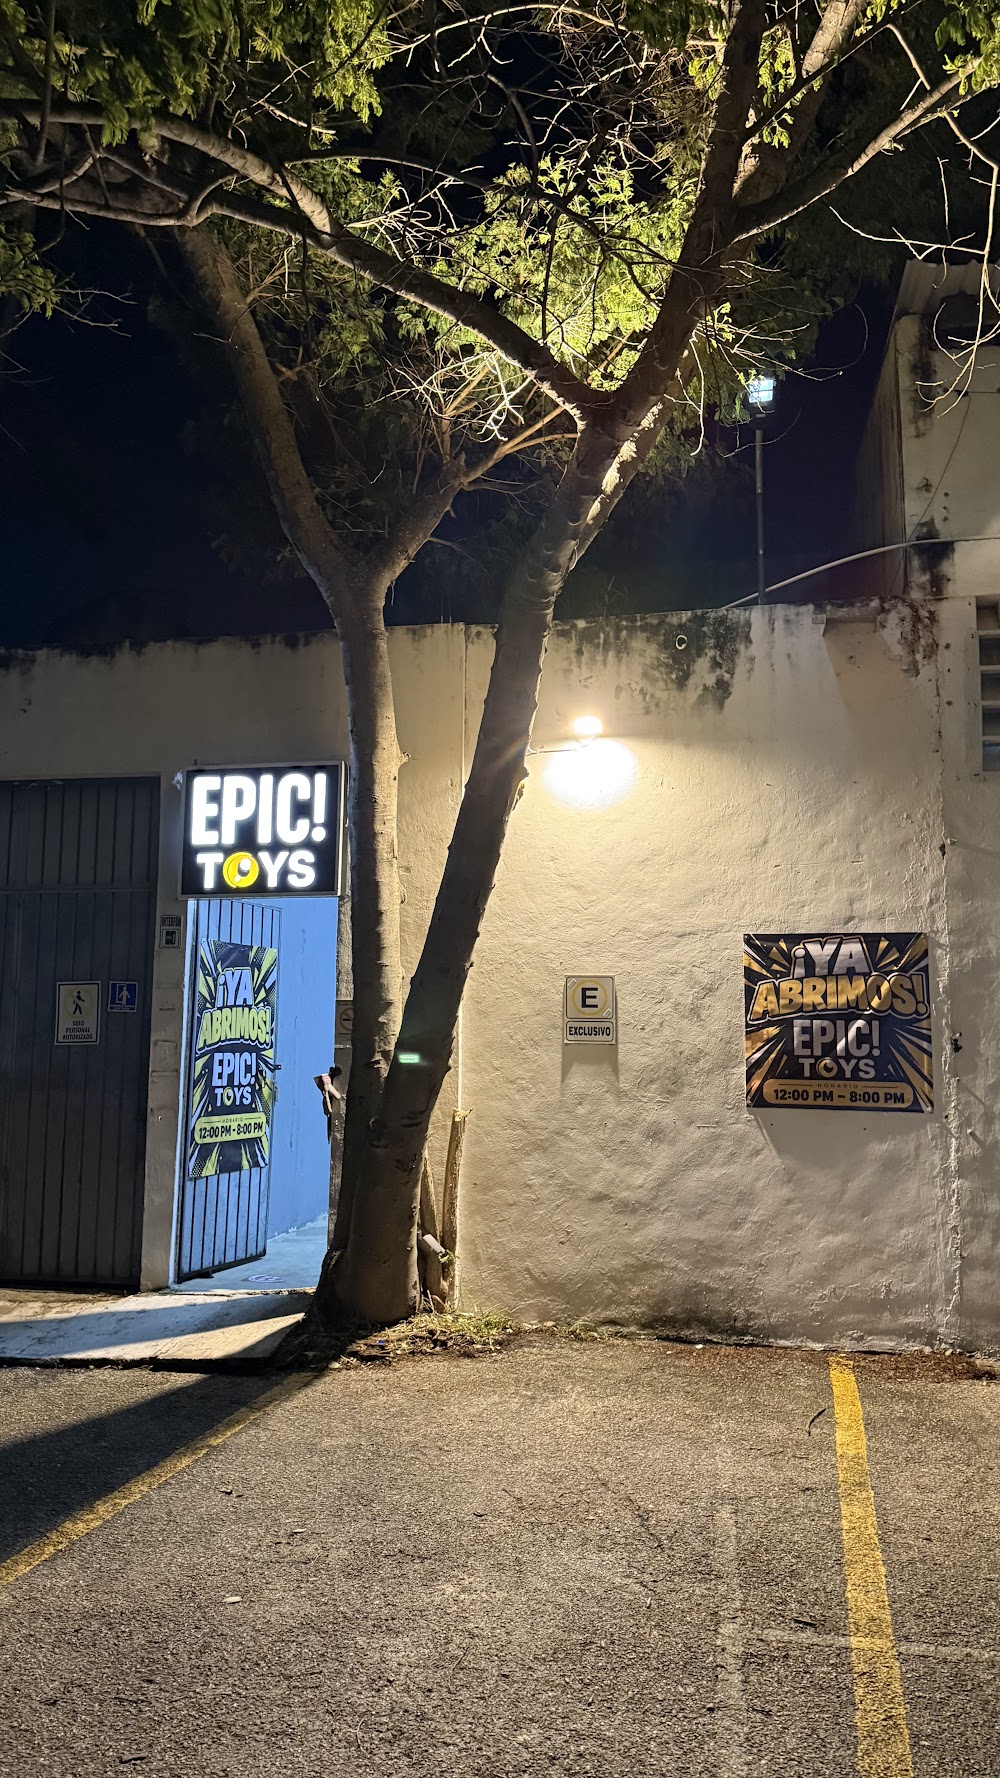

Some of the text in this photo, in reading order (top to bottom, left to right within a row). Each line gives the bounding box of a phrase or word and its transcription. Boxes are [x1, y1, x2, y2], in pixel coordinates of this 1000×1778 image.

[191, 773, 327, 846] EPIC!
[196, 850, 316, 889] TOYS
[793, 938, 870, 978] ¡YA
[217, 968, 253, 1008] ¡YA
[581, 987, 598, 1008] E
[750, 974, 929, 1020] ABRIMOS!
[197, 1007, 271, 1049] ABRIMOS!
[568, 1026, 611, 1036] EXCLUSIVO
[793, 1019, 881, 1057] EPIC!
[212, 1052, 256, 1087] EPIC!
[798, 1057, 876, 1079] TOYS
[214, 1086, 252, 1107] TOYS
[774, 1089, 809, 1101] 12:00
[813, 1090, 834, 1102] PM
[849, 1091, 880, 1103] 8:00
[884, 1092, 905, 1104] PM
[199, 1126, 219, 1139] 12:00
[220, 1125, 231, 1137] PM
[237, 1123, 252, 1135] 8:00
[253, 1121, 264, 1133] PM
